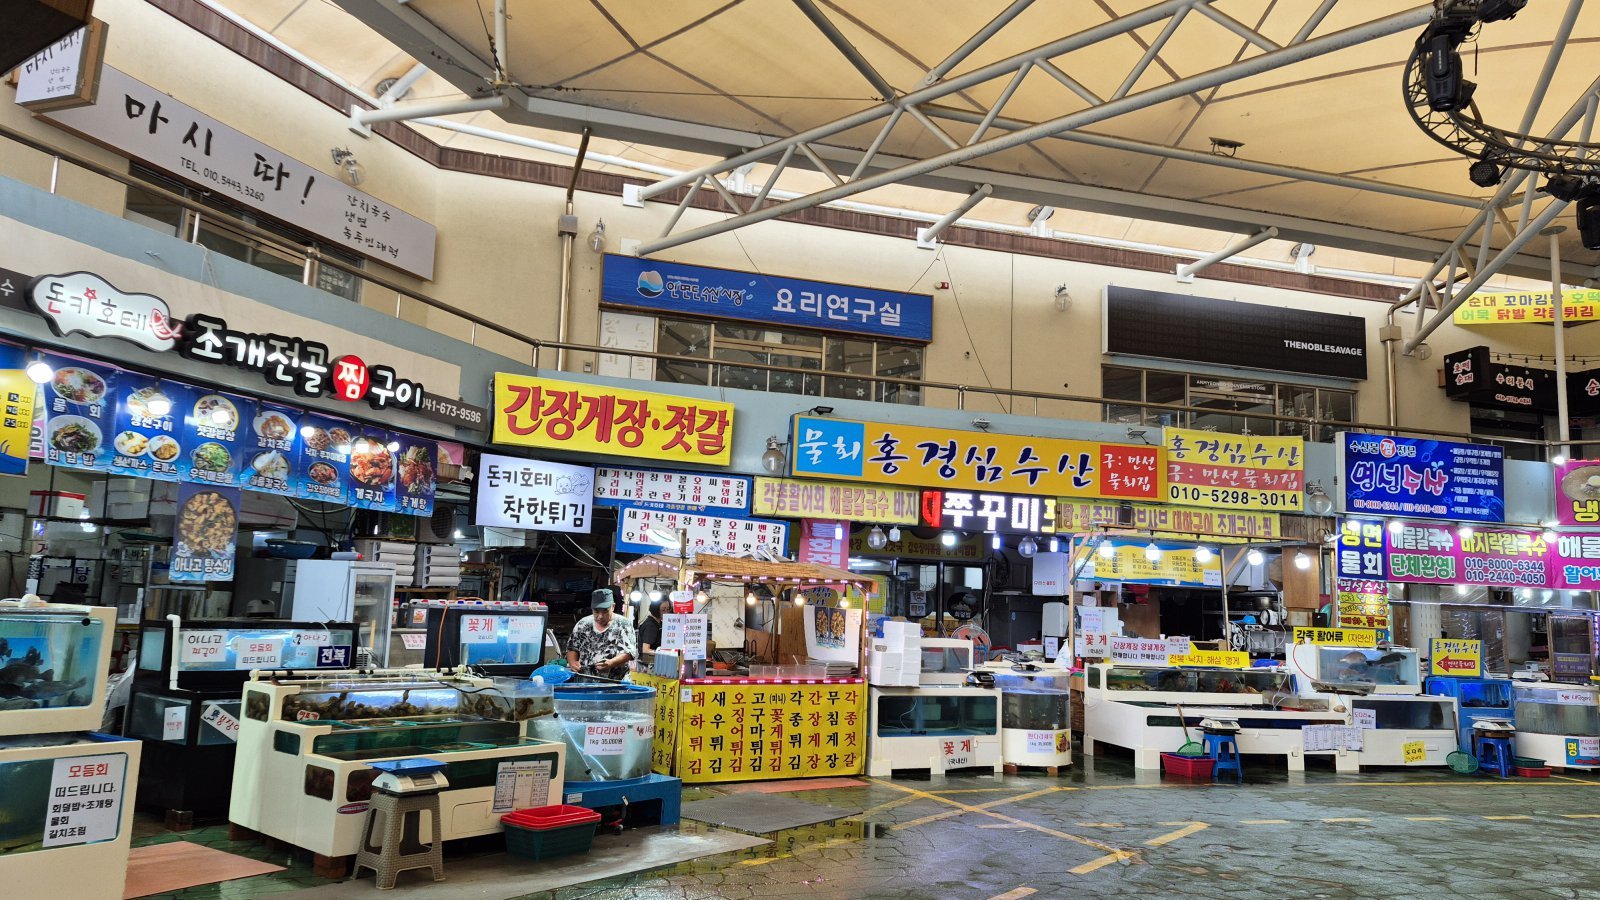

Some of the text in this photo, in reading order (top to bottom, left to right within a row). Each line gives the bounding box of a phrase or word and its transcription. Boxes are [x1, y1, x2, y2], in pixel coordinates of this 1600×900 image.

[45, 282, 149, 331] 돈키호테
[772, 287, 902, 328] 요리연구실
[1462, 309, 1490, 321] 어묵
[1497, 307, 1527, 320] 닭발
[1468, 296, 1497, 308] 순대
[191, 316, 328, 394] 조개전골
[1283, 339, 1363, 356] THENOBLESAVAGE
[799, 428, 862, 466] 물회
[867, 432, 1095, 489] 홍경심수산
[1169, 435, 1300, 467] 홍경심수산
[487, 464, 552, 488] 돈키호테
[1108, 472, 1152, 492] 물회집
[1170, 485, 1298, 507] 010-5298-3014
[503, 495, 586, 528] 착한튀김
[174, 557, 202, 573] 아나고
[1341, 550, 1383, 577] 물회
[1389, 553, 1457, 580] 단체환영!
[1465, 556, 1545, 573] 010-8000-6344
[1465, 570, 1546, 585] 010-2440-4050
[468, 618, 493, 632] 꽃게
[1317, 630, 1343, 642] 활어류
[321, 648, 346, 663] 전복
[708, 691, 726, 774] 새우튀김
[728, 691, 746, 773] 오징어튀김
[749, 692, 766, 772] 고구마튀김
[787, 690, 804, 770] 각종튀김
[806, 690, 823, 769] 간장게장
[824, 690, 841, 769] 무침게장
[842, 690, 859, 767] 각종젓갈
[943, 739, 972, 756] 꽃게
[55, 782, 117, 798] 떠드립니다.
[49, 826, 87, 840] 갈치조림
